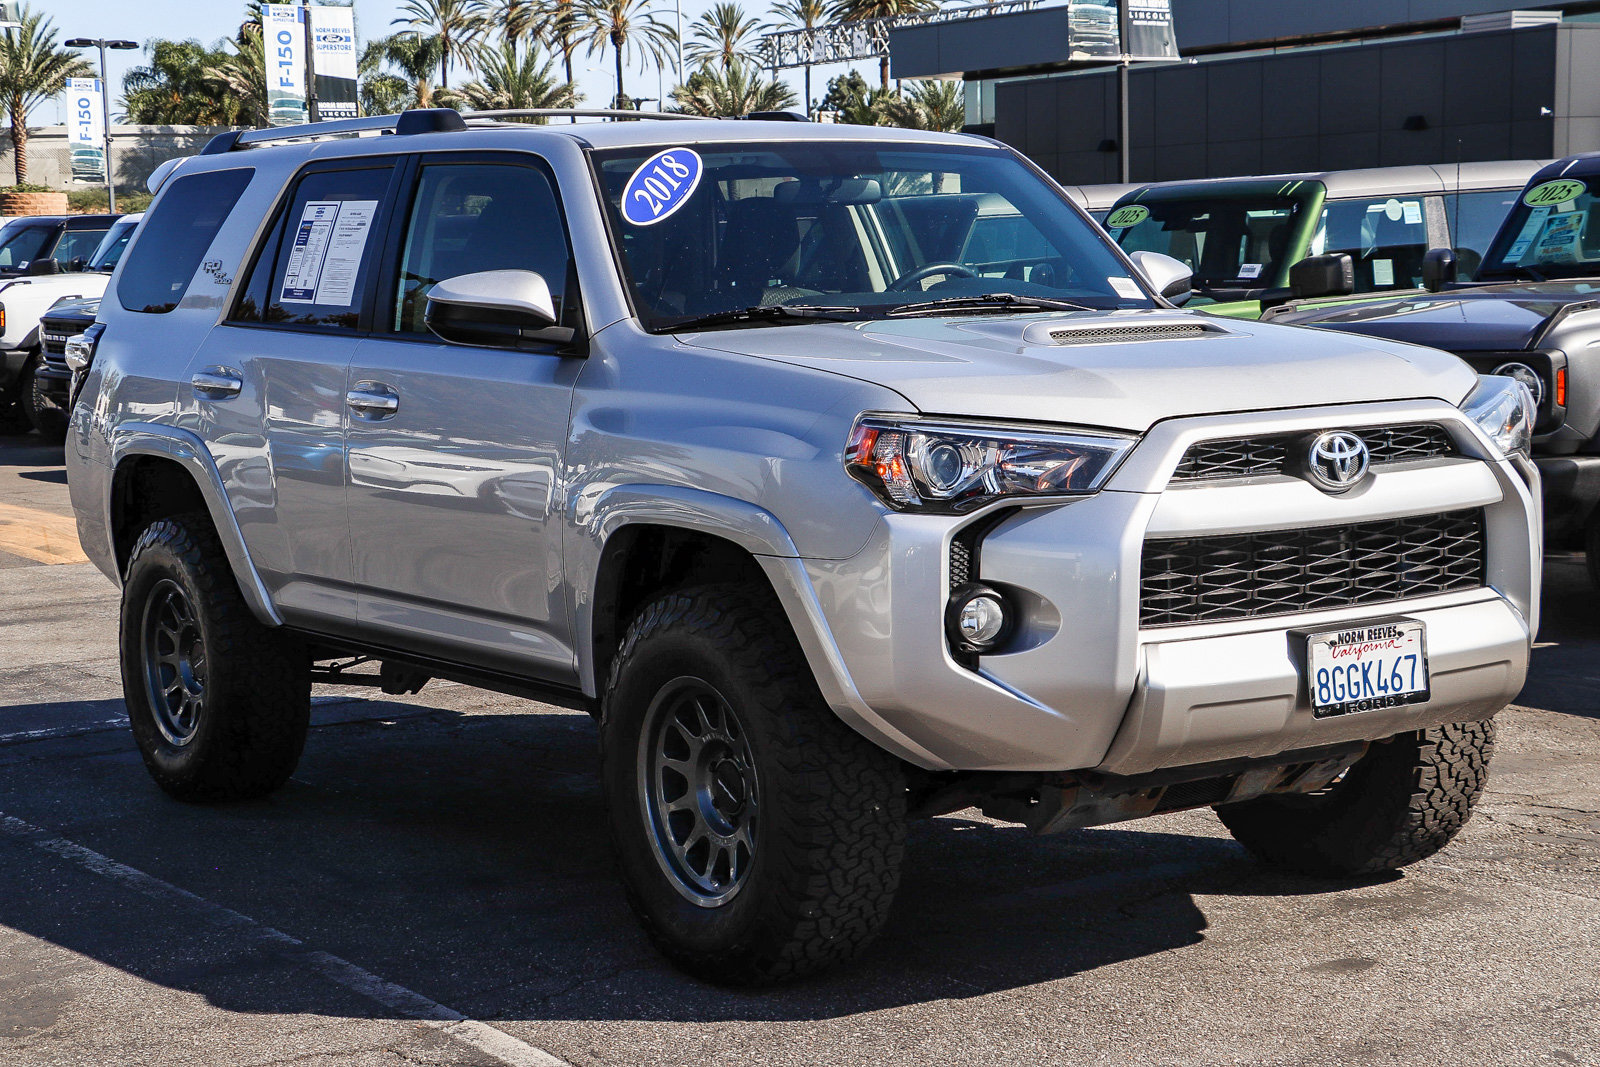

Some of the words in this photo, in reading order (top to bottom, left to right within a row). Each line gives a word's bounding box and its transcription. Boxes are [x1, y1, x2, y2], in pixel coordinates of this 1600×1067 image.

[1128, 11, 1171, 20] LINCOLN
[276, 30, 295, 87] F-150
[77, 97, 93, 141] F-150
[634, 155, 690, 217] 2018
[1529, 183, 1579, 204] 2025
[1111, 210, 1146, 225] 2025
[1337, 629, 1365, 645] NORM
[1367, 625, 1397, 641] REEVES
[1331, 639, 1403, 661] California
[1316, 653, 1418, 704] 8GGK467
[1347, 696, 1396, 714] FORD
